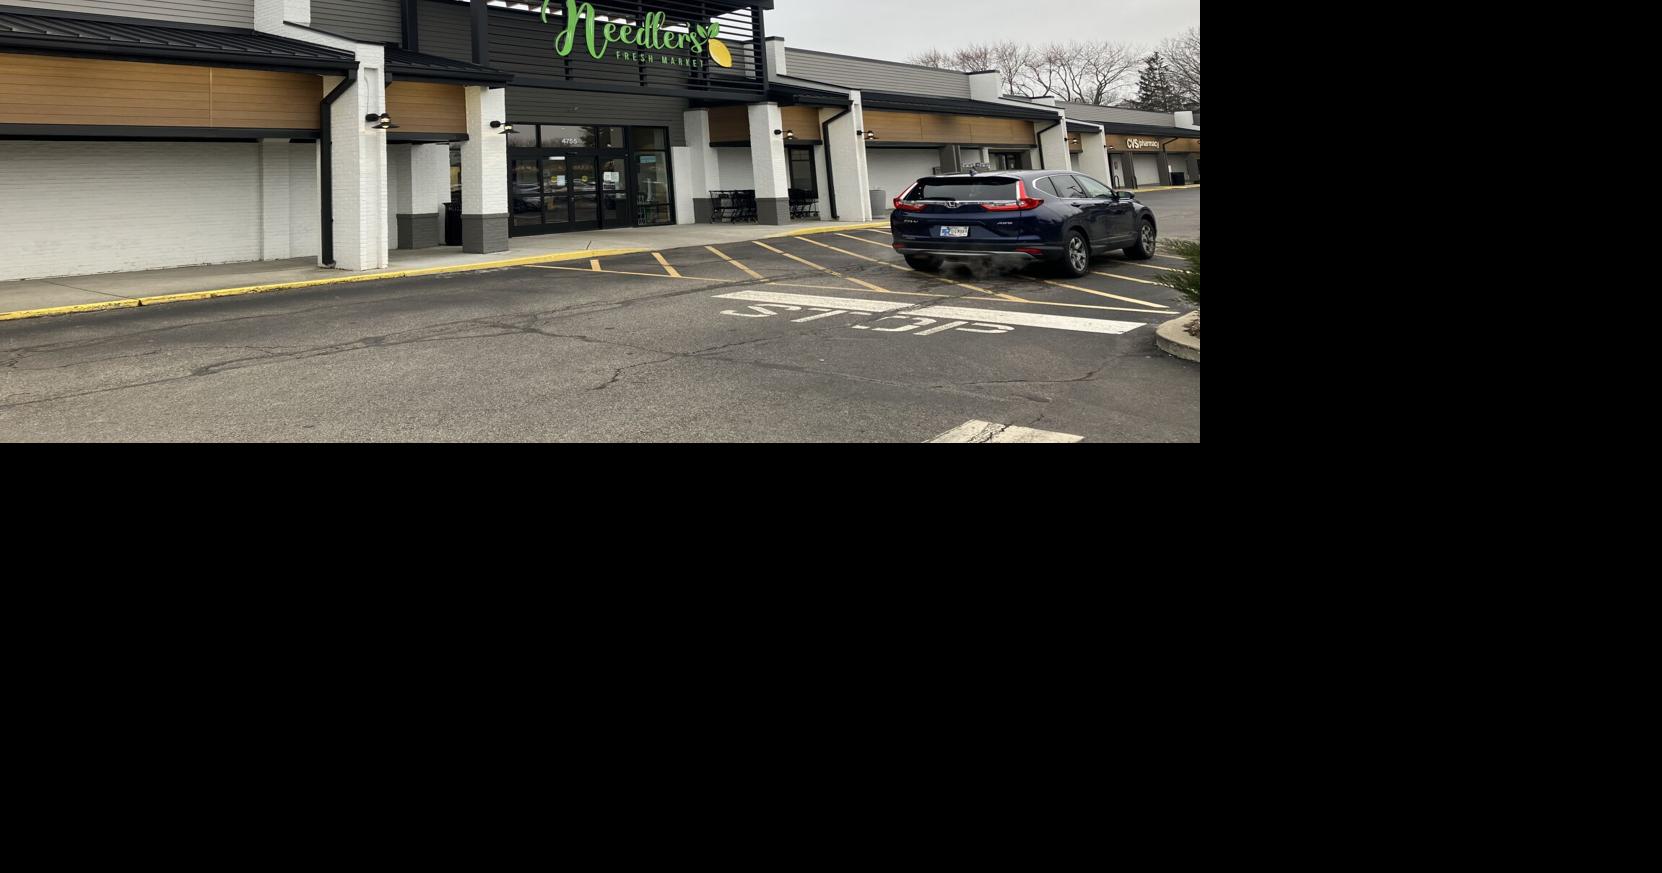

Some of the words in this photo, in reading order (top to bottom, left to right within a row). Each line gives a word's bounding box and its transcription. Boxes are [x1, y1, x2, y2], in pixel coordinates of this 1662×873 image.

[616, 51, 653, 63] FRESH
[661, 56, 704, 68] MARKET
[1126, 138, 1139, 149] CVS
[1139, 140, 1160, 149] pharmacy
[720, 303, 1015, 336] STOP
